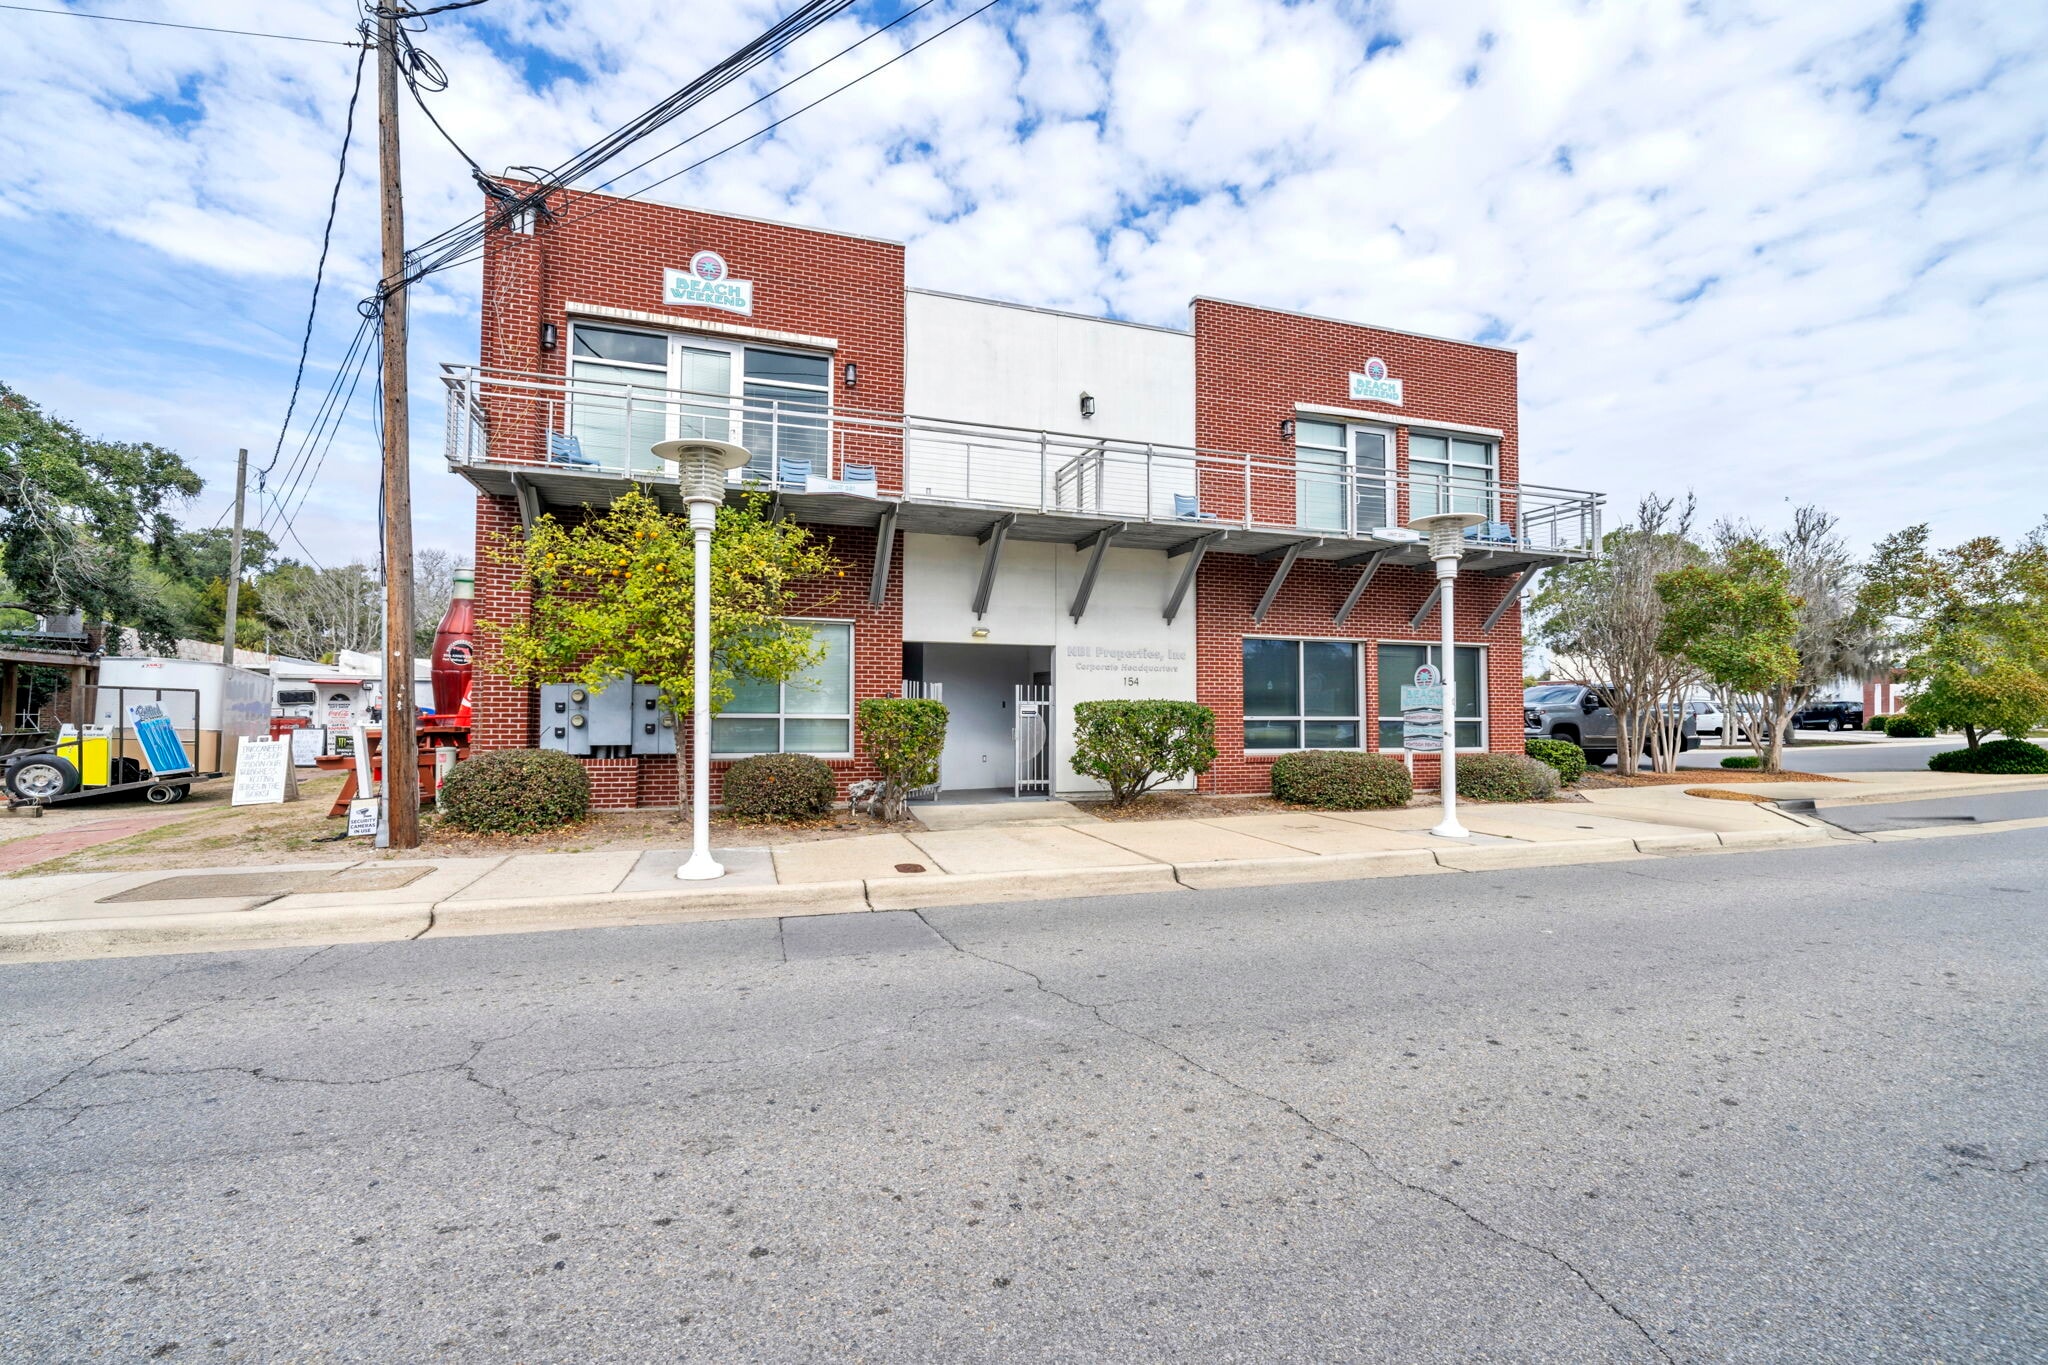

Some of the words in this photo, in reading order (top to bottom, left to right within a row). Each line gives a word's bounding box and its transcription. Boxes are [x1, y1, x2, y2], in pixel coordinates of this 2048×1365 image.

[676, 277, 741, 298] BEACH
[670, 287, 746, 308] WEEKEND
[1356, 378, 1396, 392] BEACH
[1354, 387, 1399, 400] WEEKEND
[1167, 648, 1187, 661] Inc
[1123, 676, 1139, 687] 154
